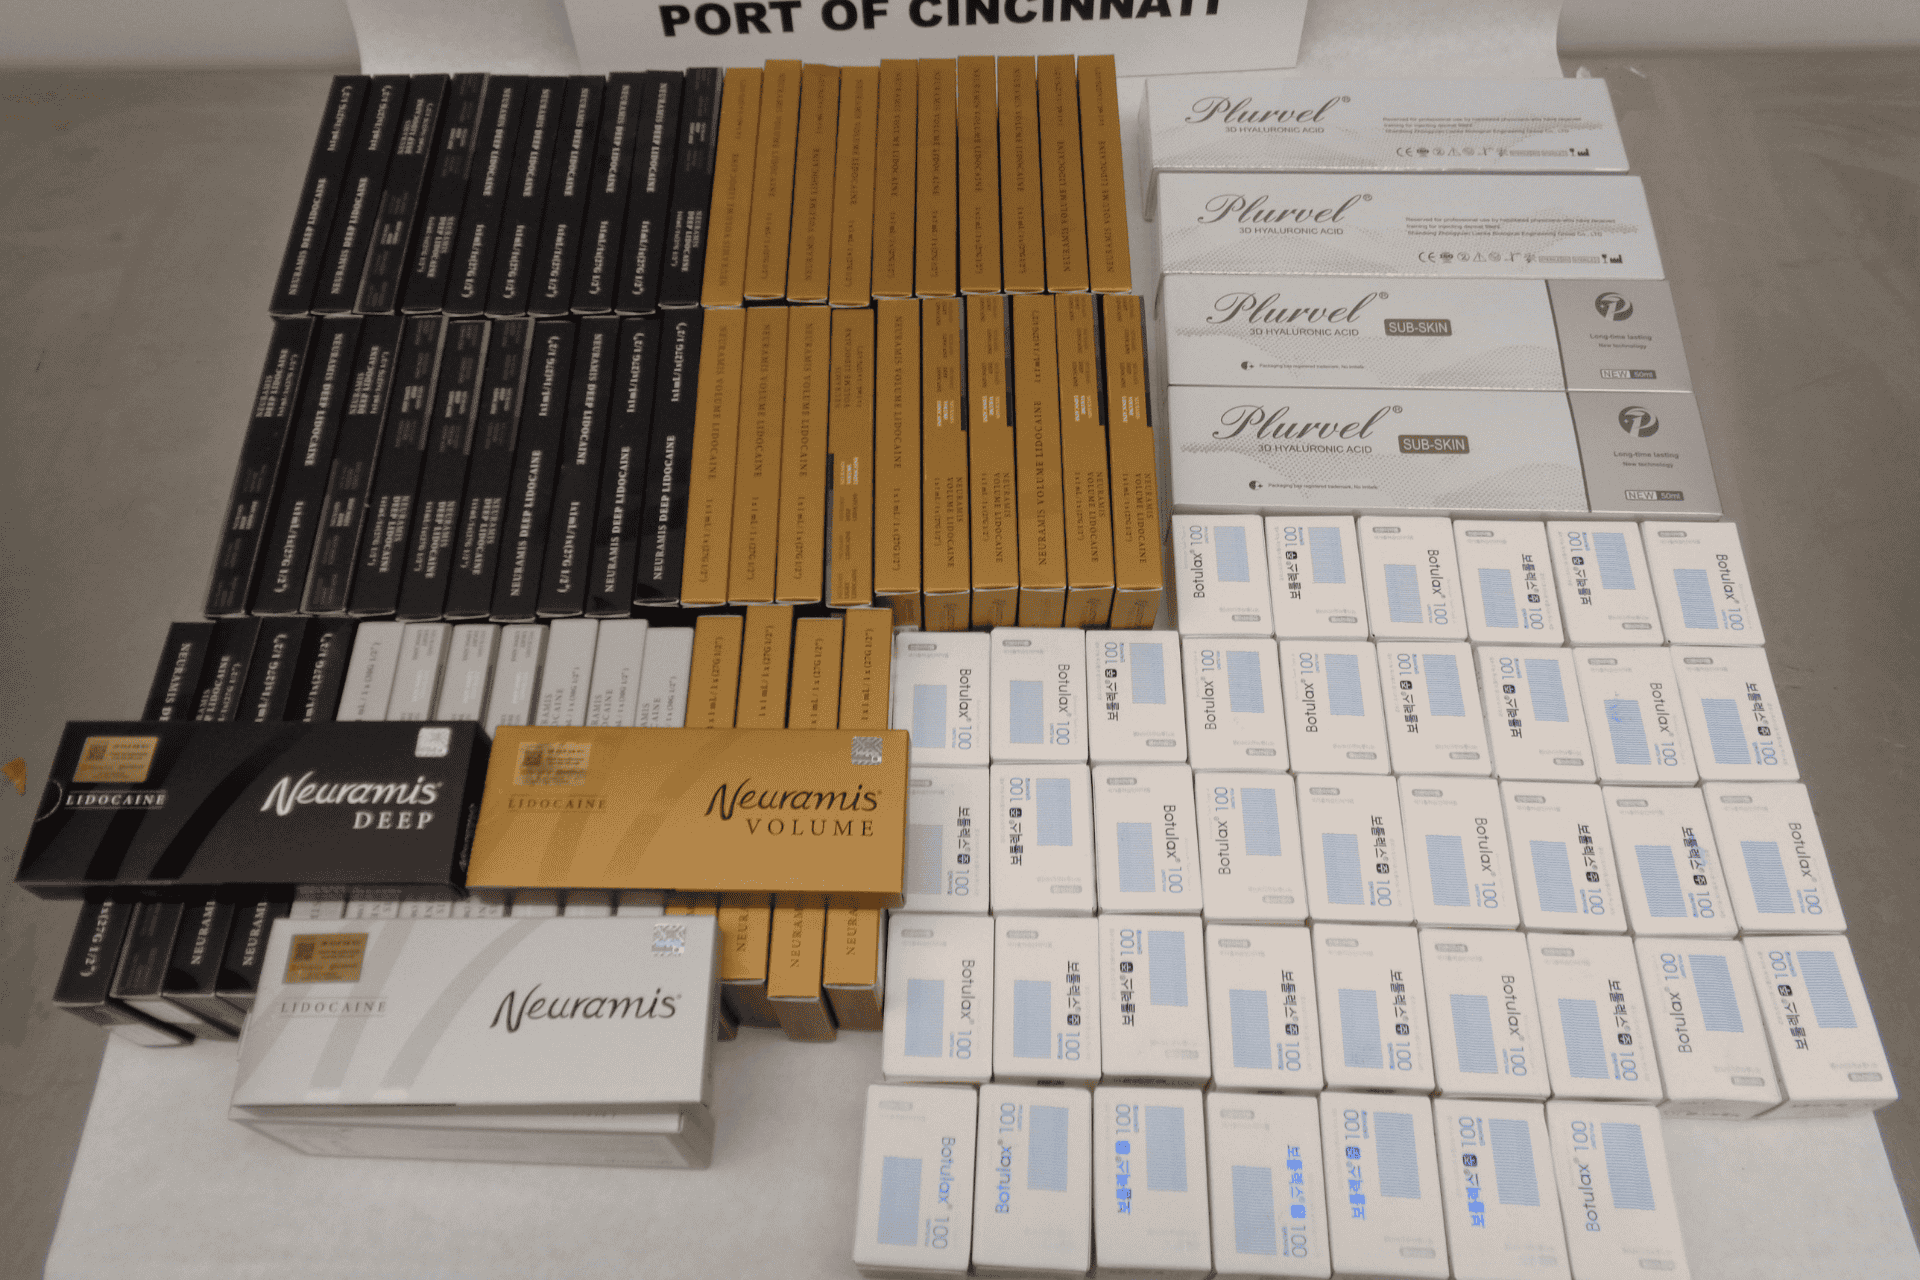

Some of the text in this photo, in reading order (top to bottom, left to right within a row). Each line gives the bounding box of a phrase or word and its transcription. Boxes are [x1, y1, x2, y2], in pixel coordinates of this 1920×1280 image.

[660, 1, 803, 37] PORT
[820, 0, 889, 31] OF
[1238, 126, 1301, 134] HYALURONIC
[1253, 227, 1318, 235] HYALURONIC
[1320, 227, 1344, 235] ACID
[1263, 328, 1331, 337] HYALURONIC
[1388, 321, 1448, 335] SUB-SKIN
[1603, 370, 1627, 378] NEW
[1258, 445, 1372, 454] 3D HYALURONIC ACID
[1403, 438, 1466, 452] SUB-SKIN
[653, 435, 676, 580] NEURAMIS DEEP LIDOCAINE
[1629, 491, 1654, 500] NEW
[1190, 525, 1203, 546] 100
[1283, 526, 1296, 547] 100
[1567, 531, 1580, 552] 100
[1434, 602, 1449, 625] 100
[1529, 605, 1545, 630] 100
[1729, 607, 1745, 631] 100
[1104, 642, 1118, 664] 100
[1201, 649, 1215, 673] 100
[1299, 652, 1313, 675] 100
[1397, 653, 1411, 676] 100
[1499, 657, 1514, 678] 100
[957, 725, 972, 751] 100
[1055, 720, 1070, 746] 100
[1661, 741, 1678, 767] 100
[1762, 740, 1778, 766] 100
[66, 794, 166, 806] LIDOCAINE
[1009, 777, 1024, 802] 100
[1213, 786, 1228, 811] 100
[353, 811, 433, 830] DEEP
[746, 819, 874, 837] VOLUME
[954, 870, 969, 897] 100
[1167, 867, 1183, 894] 100
[1376, 878, 1392, 907] 100
[1483, 881, 1499, 909] 100
[1587, 888, 1605, 916] 100
[1697, 891, 1715, 919] 100
[1801, 887, 1823, 916] 100
[190, 900, 217, 966] NEURAMI
[242, 900, 269, 967] NEURAMI
[1119, 928, 1134, 957] 100
[1660, 953, 1676, 980] 100
[1768, 950, 1785, 979] 100
[280, 1000, 387, 1013] LIDOCAINE
[956, 1029, 972, 1061] 100
[1065, 1031, 1081, 1062] 100
[1284, 1040, 1301, 1071] 100
[1396, 1041, 1412, 1072] 100
[1510, 1046, 1527, 1077] 100
[1621, 1051, 1639, 1082] 100
[1000, 1102, 1016, 1133] 100
[1115, 1103, 1131, 1133] 100
[1343, 1109, 1359, 1140] 100
[1458, 1116, 1475, 1147] 100
[1570, 1120, 1588, 1151] 100
[932, 1217, 949, 1249] 100
[1290, 1225, 1308, 1258] 100
